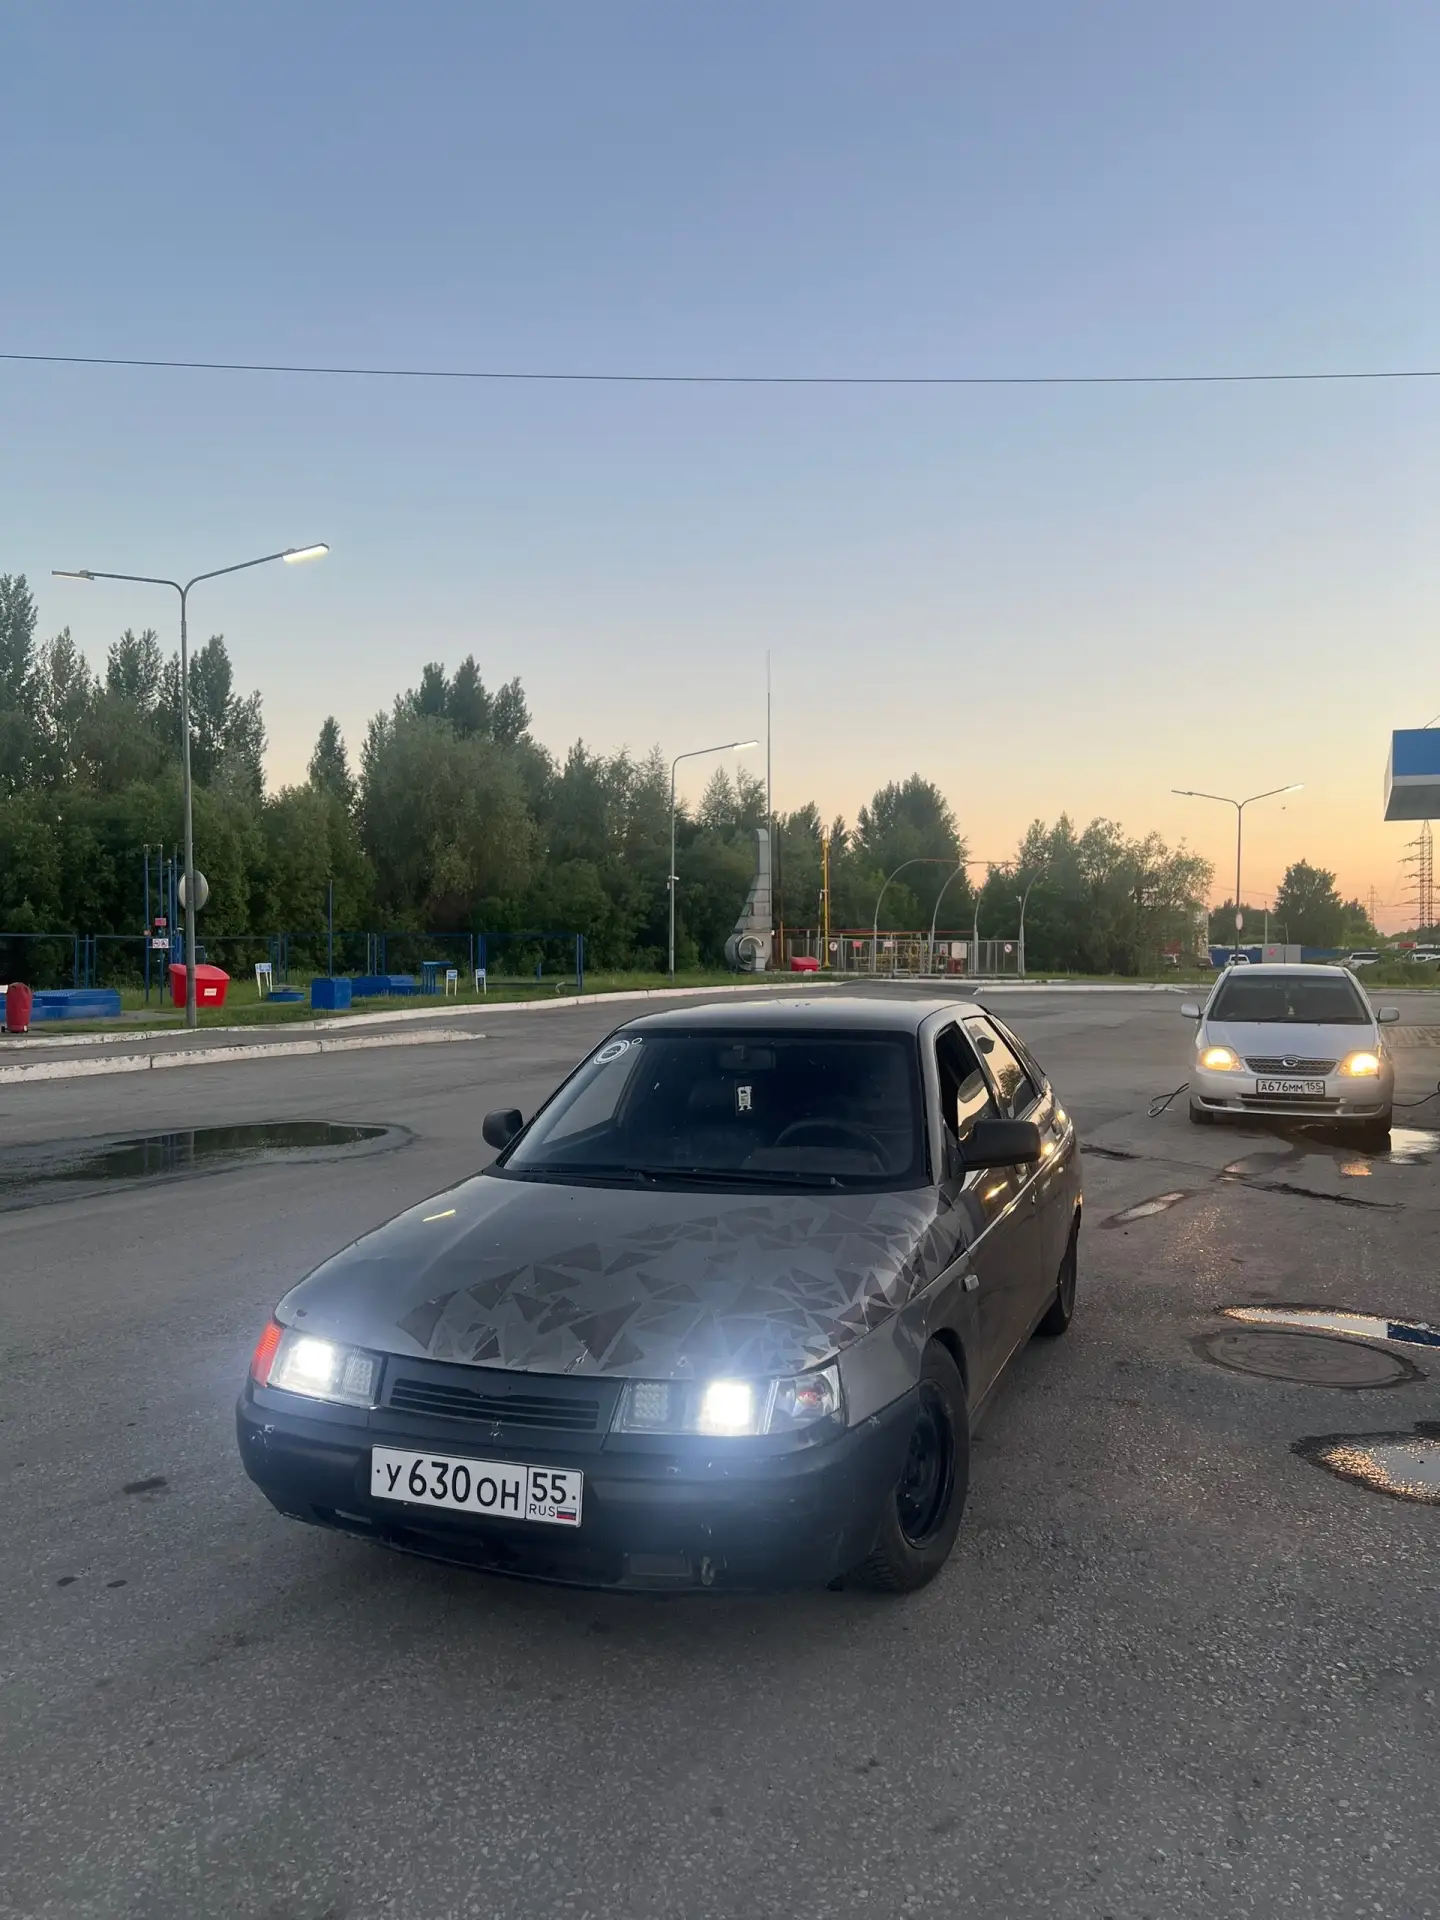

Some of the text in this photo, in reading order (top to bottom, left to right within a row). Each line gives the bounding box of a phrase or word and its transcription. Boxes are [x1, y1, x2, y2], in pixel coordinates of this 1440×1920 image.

[1305, 1082, 1321, 1090] 155
[386, 1459, 567, 1511] У630ОН 55
[529, 1503, 556, 1517] RUS
